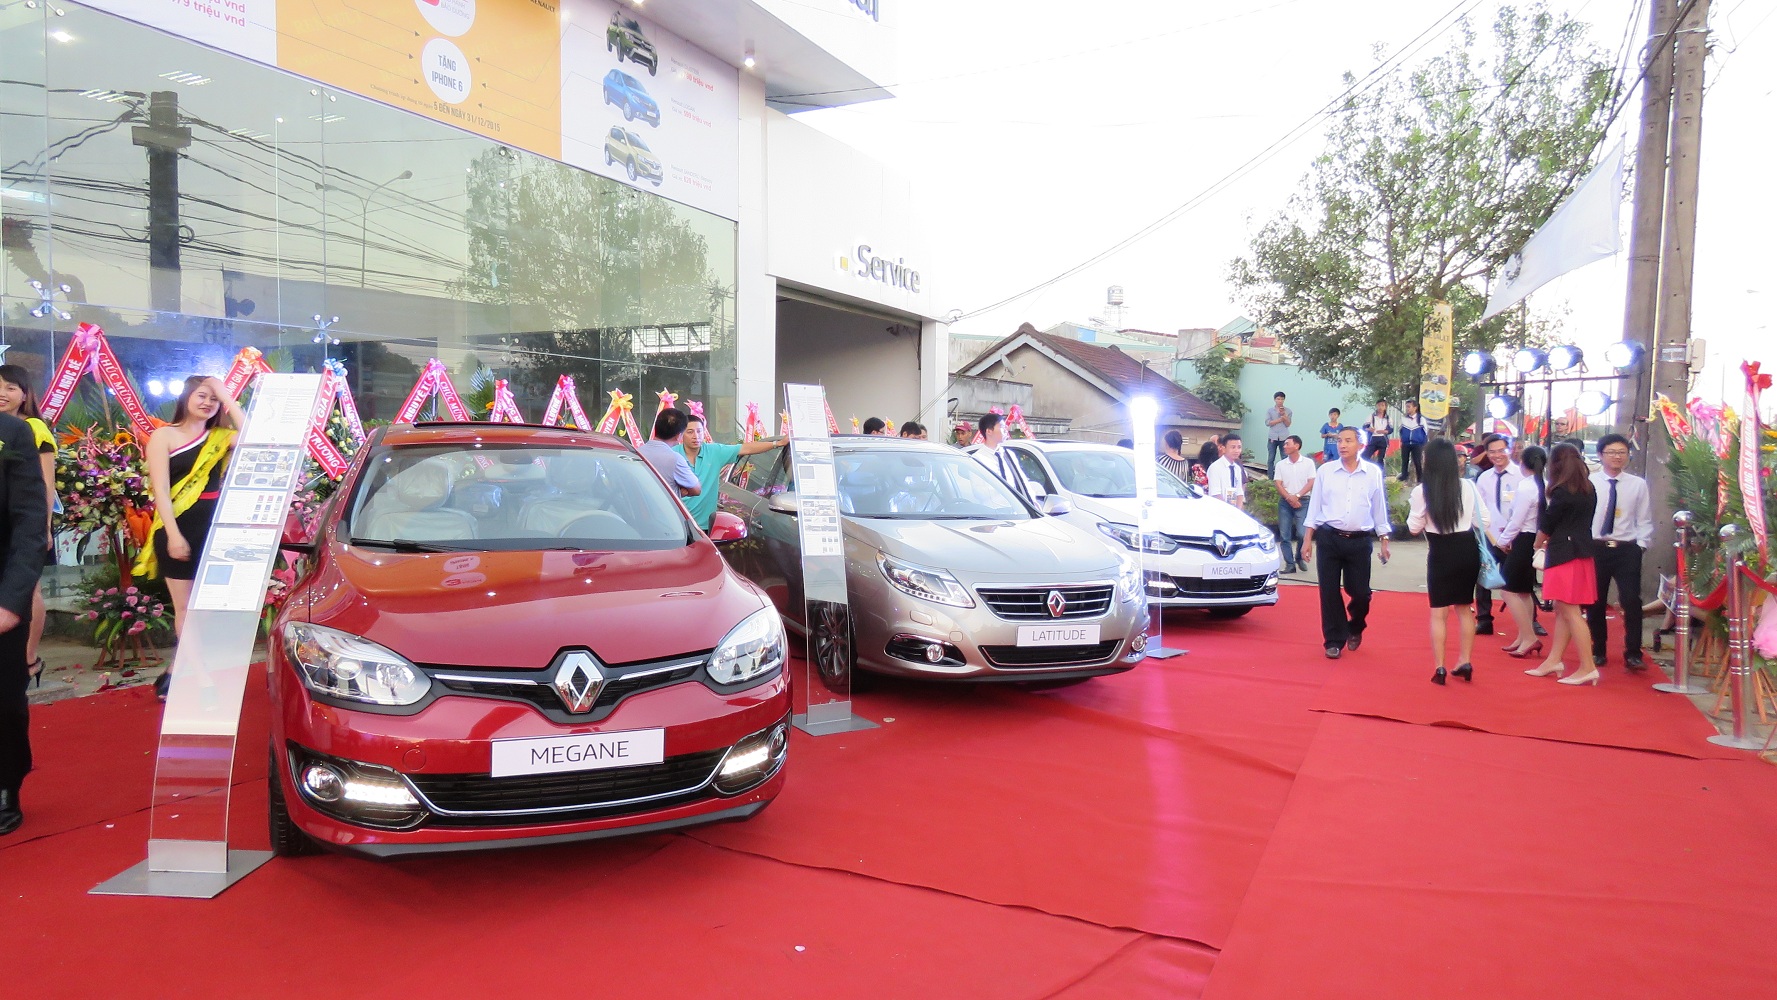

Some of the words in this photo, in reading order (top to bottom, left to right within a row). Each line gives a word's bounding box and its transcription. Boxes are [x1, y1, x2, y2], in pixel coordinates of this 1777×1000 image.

[194, 1, 221, 18] triệu
[224, 13, 246, 27] vnd
[437, 54, 457, 72] TẶNG
[431, 70, 458, 90] IPHONE
[458, 80, 463, 92] 6
[433, 101, 438, 111] 5
[438, 102, 451, 115] ĐẾN
[451, 107, 466, 120] NGÀY
[467, 113, 500, 132] 31/12/2015
[857, 244, 920, 293] Service
[98, 352, 120, 381] CHÚC
[113, 380, 137, 412] MỪNG
[440, 380, 455, 402] CHÚC
[316, 397, 329, 420] GIA
[308, 432, 340, 469] TRƯƠNG
[1742, 450, 1753, 471] SẢN
[1743, 472, 1756, 497] ĐỘNG
[1211, 566, 1243, 576] MEGANE
[1032, 629, 1086, 642] LATITUDE
[530, 740, 630, 765] MEGANE
